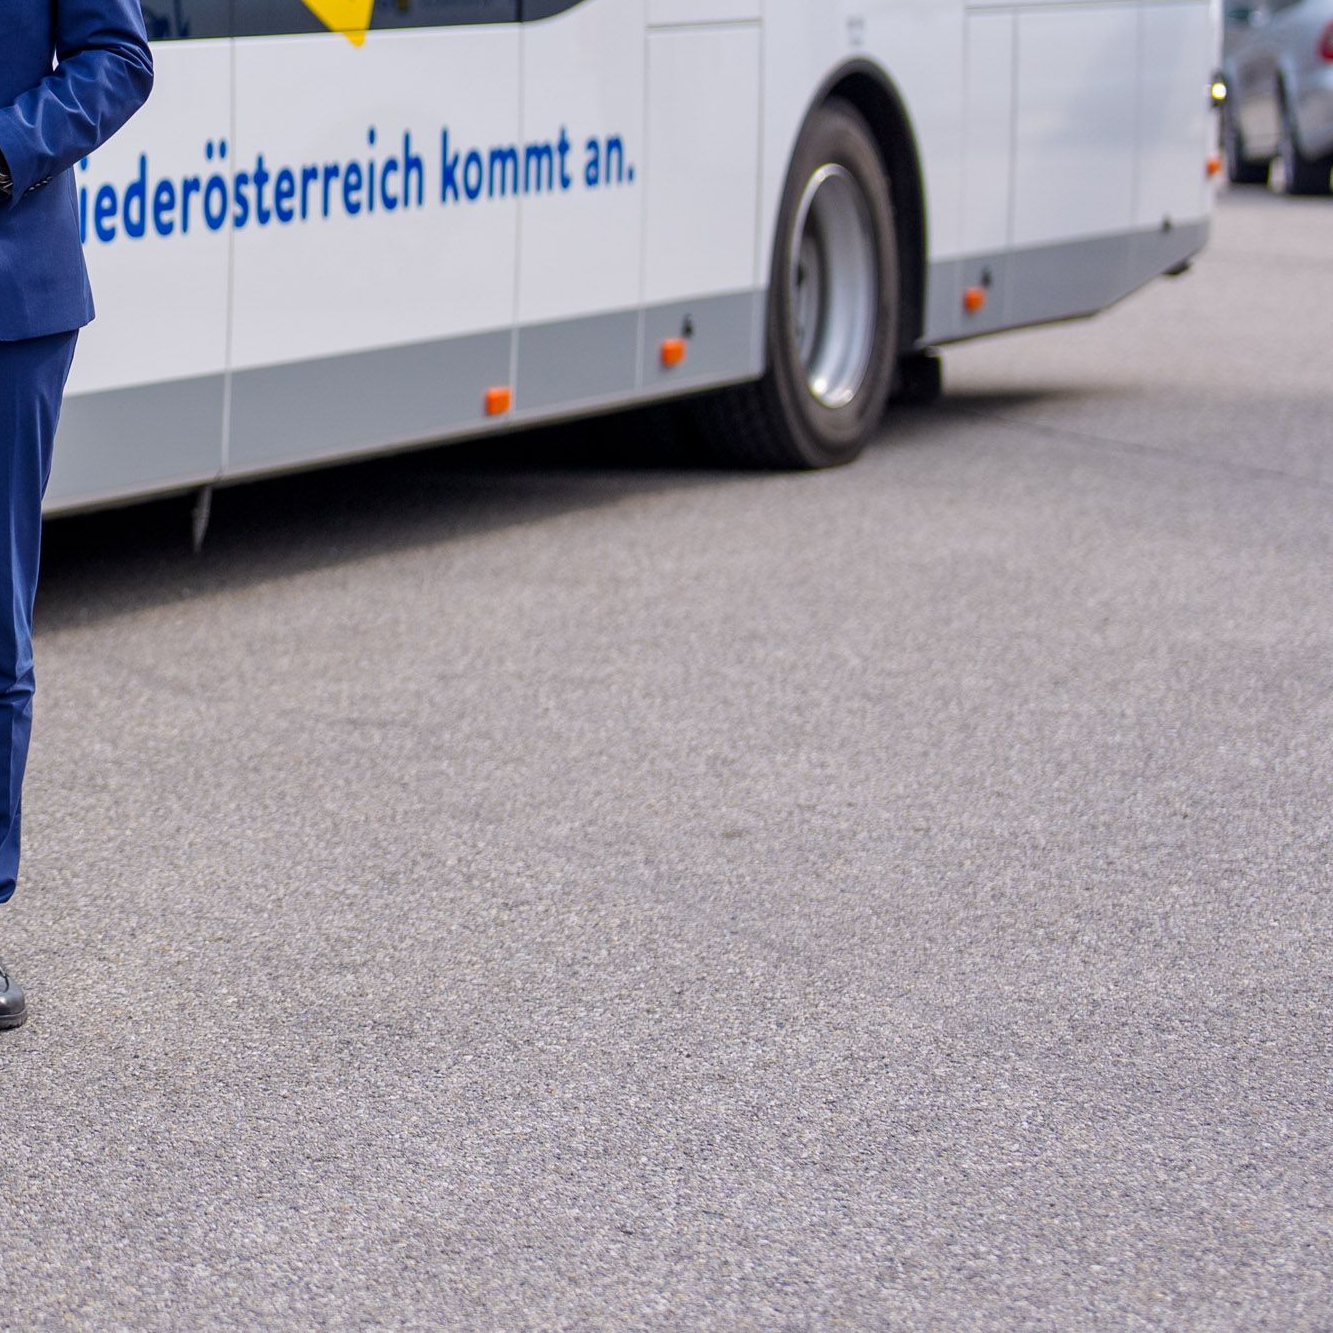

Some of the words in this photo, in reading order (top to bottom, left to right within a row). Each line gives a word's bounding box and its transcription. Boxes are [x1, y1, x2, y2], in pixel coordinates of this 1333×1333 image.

[79, 127, 424, 245] iederösterreich
[441, 125, 571, 204] kommt
[585, 132, 635, 189] an.
